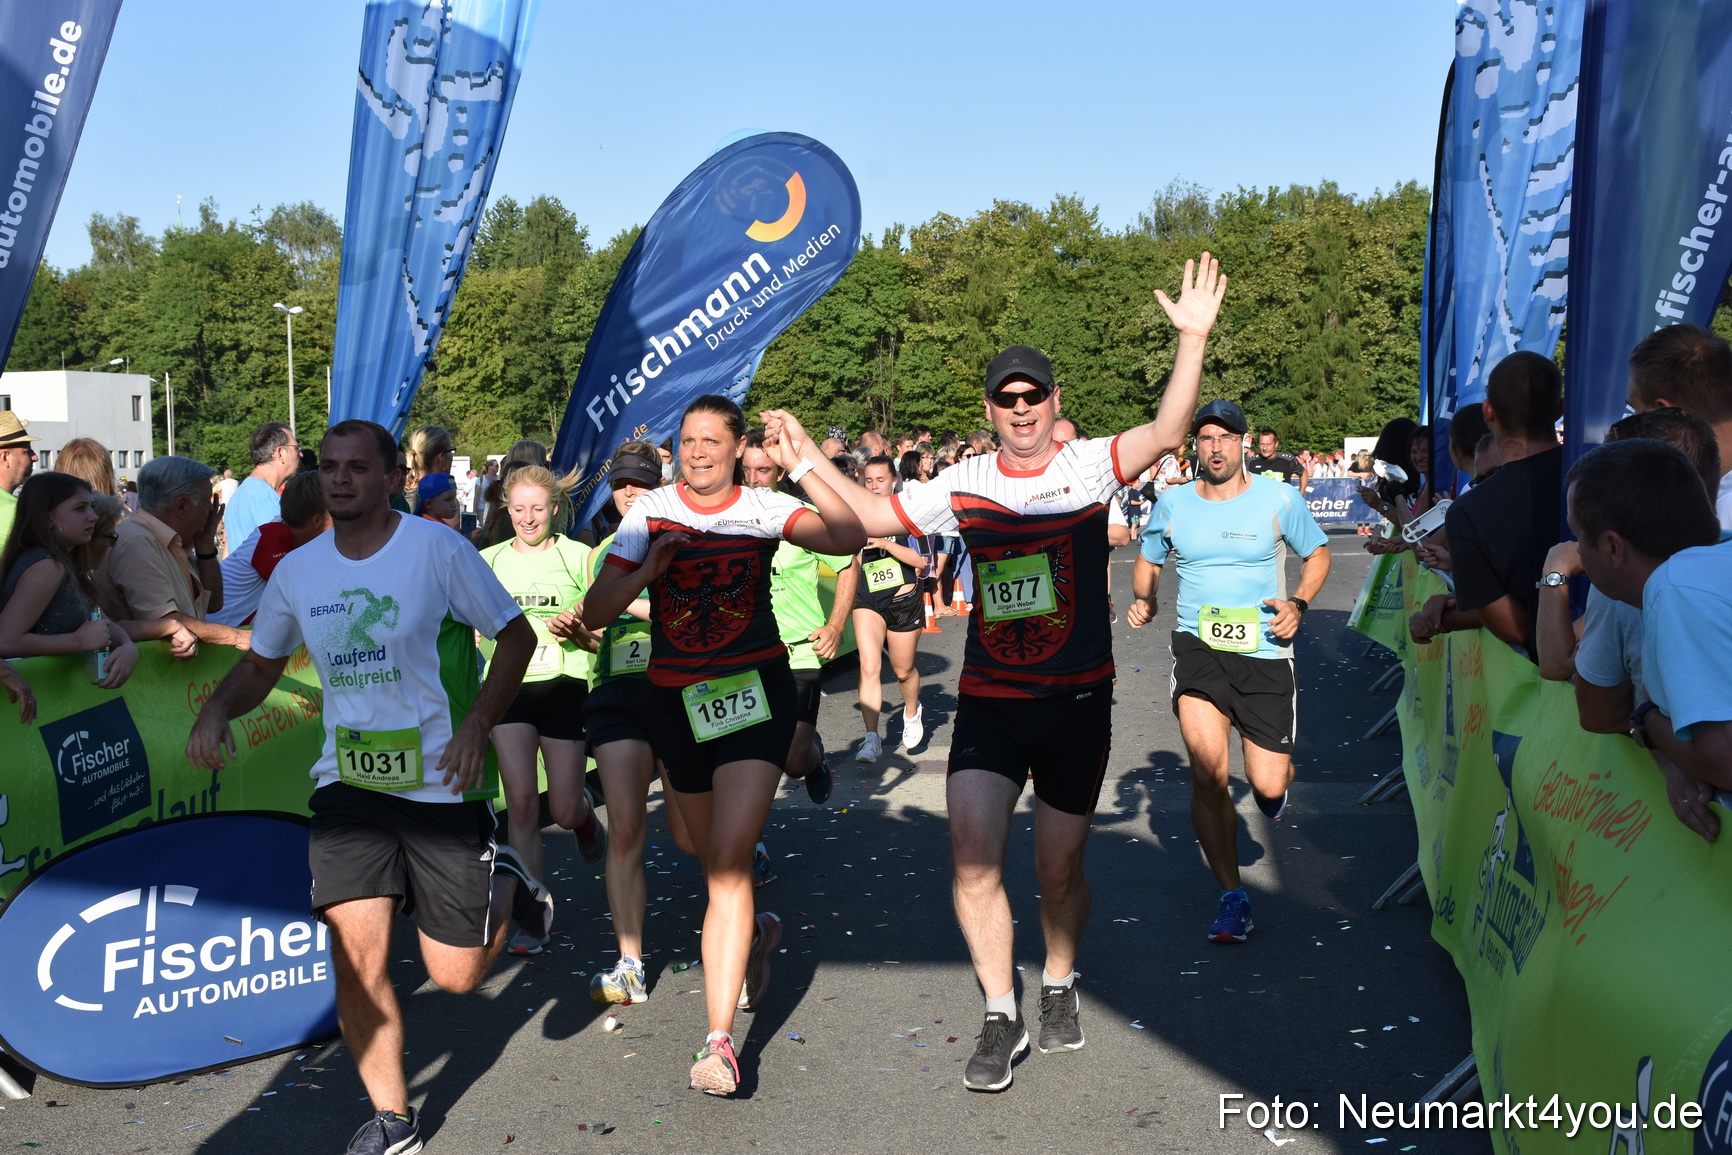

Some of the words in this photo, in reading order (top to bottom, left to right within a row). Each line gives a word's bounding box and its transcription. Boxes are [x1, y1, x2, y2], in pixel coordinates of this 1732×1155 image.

[704, 304, 752, 351] Druck
[751, 274, 784, 309] und
[781, 222, 841, 280] Medien
[585, 252, 772, 433] Frischmann
[1305, 497, 1354, 511] scher
[1311, 510, 1348, 518] OMOBILE
[872, 568, 894, 583] 285
[987, 576, 1040, 604] 1877
[1016, 600, 1036, 608] Weber
[1211, 622, 1246, 640] 623
[327, 645, 386, 667] Laufend
[697, 689, 757, 723] 1875
[724, 711, 751, 724] Christina
[71, 737, 130, 776] Fischer
[346, 749, 407, 775] 1031
[81, 757, 130, 787] AUTOMOBILE
[371, 775, 400, 783] Andreas
[107, 784, 121, 797] das
[103, 916, 329, 993] Fischer
[133, 961, 328, 1020] AUTOMOBILE
